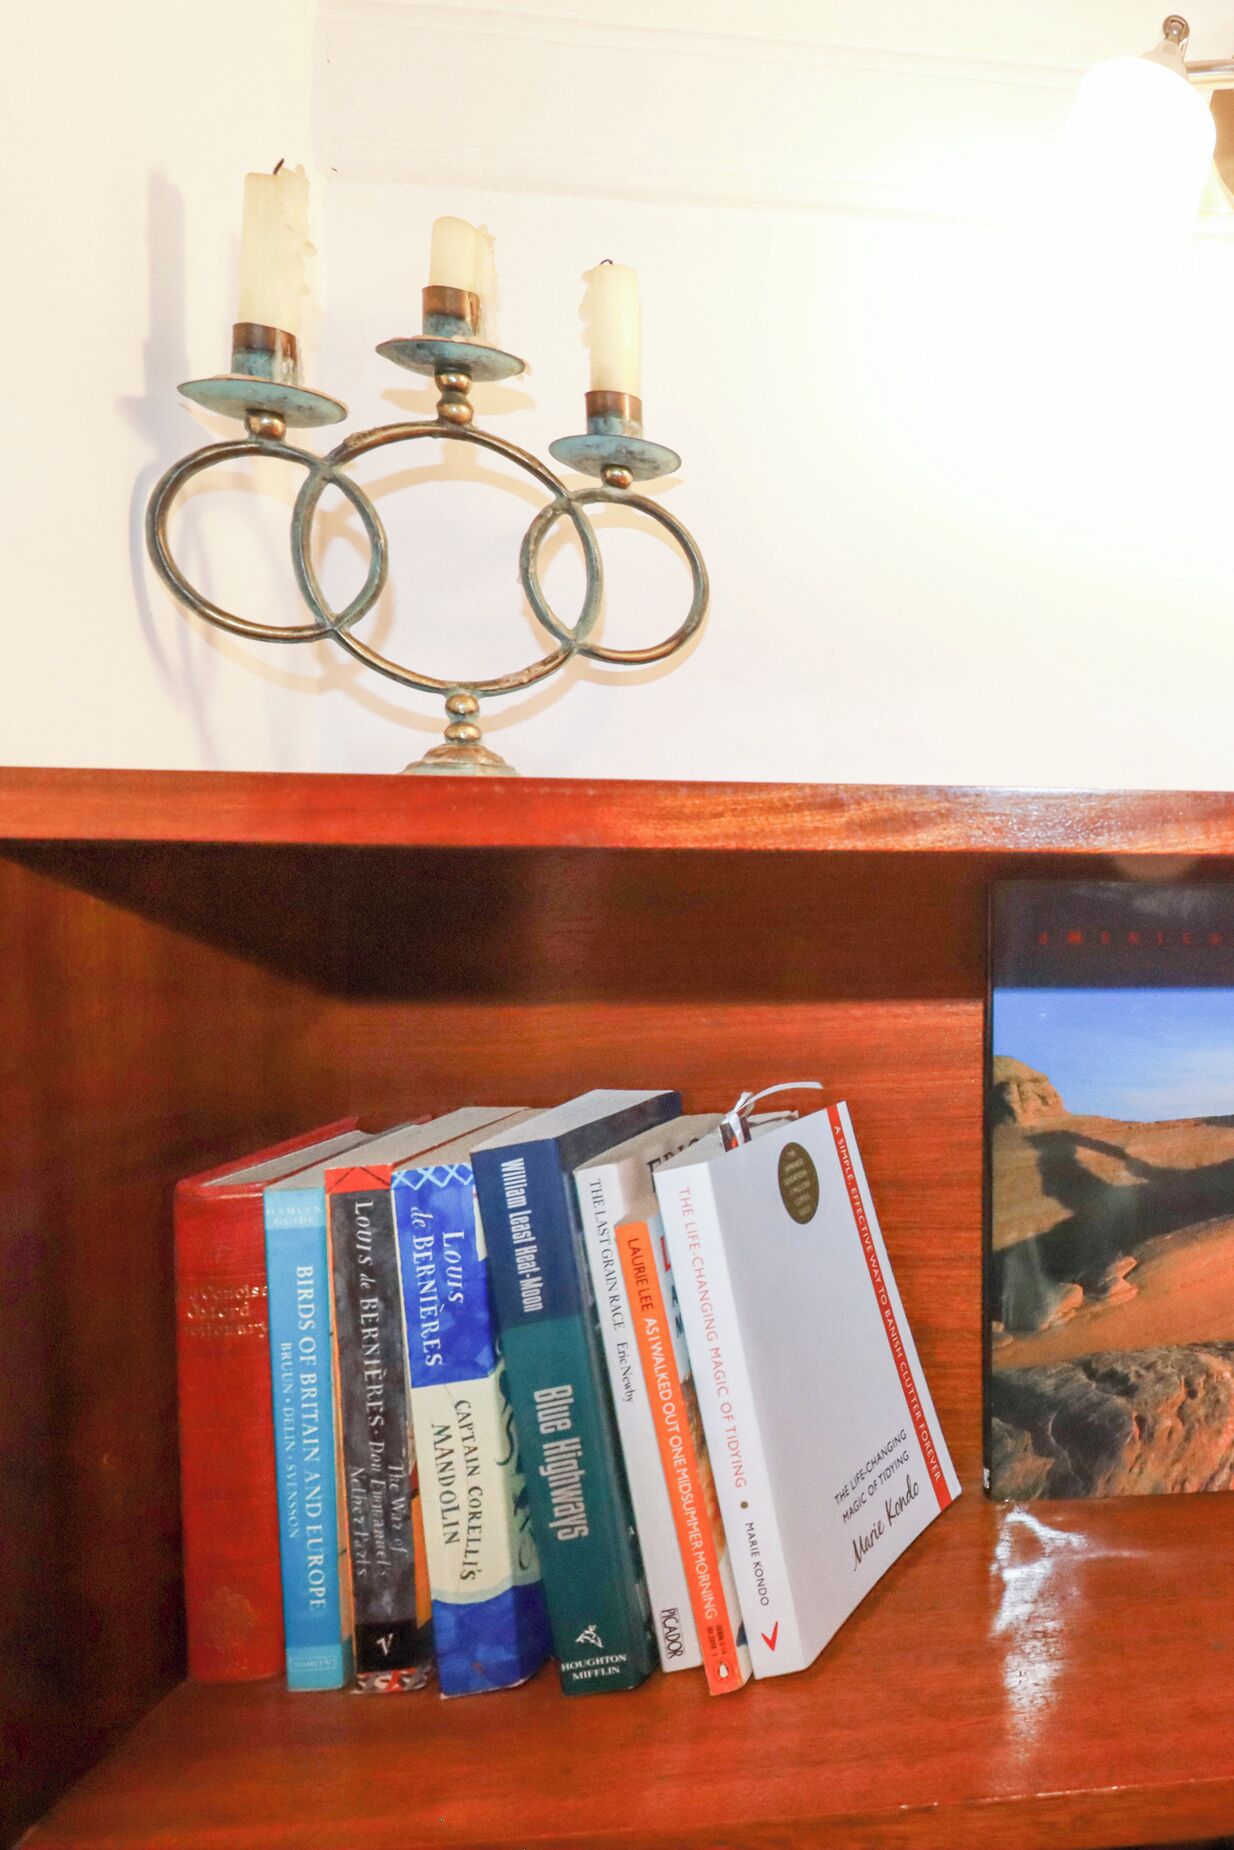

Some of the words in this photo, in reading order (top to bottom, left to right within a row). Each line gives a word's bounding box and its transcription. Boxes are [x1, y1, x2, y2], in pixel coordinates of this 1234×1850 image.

[499, 1157, 530, 1209] William
[587, 1177, 607, 1209] THE
[677, 1185, 696, 1217] THE
[409, 1206, 433, 1227] de
[507, 1209, 536, 1244] Least
[593, 1209, 612, 1246] LAST
[849, 1186, 874, 1253] EFFECTIVE
[358, 1273, 376, 1289] de
[512, 1244, 548, 1313] Heat-Moon
[599, 1247, 620, 1292] GRAIN
[626, 1237, 649, 1286] LAURIE
[683, 1219, 720, 1343] LIFE-CHANGING
[868, 1253, 883, 1284] WAY
[294, 1264, 314, 1330] BIRDS
[410, 1234, 450, 1366] BERNIÈRES
[607, 1294, 626, 1331] RACE
[636, 1287, 654, 1312] LEE
[877, 1286, 889, 1306] TO
[297, 1335, 315, 1365] OF
[642, 1315, 660, 1336] AS
[882, 1307, 904, 1359] BANISH
[280, 1342, 293, 1393] BRUUN
[358, 1297, 390, 1427] BERNIÈRES
[615, 1341, 630, 1365] Eric
[647, 1339, 674, 1402] WALKED
[708, 1346, 730, 1397] MAGIC
[533, 1383, 577, 1434] Blue
[617, 1366, 637, 1405] Newby
[898, 1360, 923, 1423] CLUTTER
[282, 1407, 295, 1452] DELIN
[298, 1372, 319, 1462] BRITAIN
[660, 1400, 680, 1435] OUT
[718, 1399, 735, 1423] OF
[368, 1440, 385, 1472] Don
[454, 1399, 482, 1483] CAPTAIN
[667, 1433, 687, 1468] ONE
[722, 1425, 747, 1490] TIDYING
[916, 1421, 942, 1482] FOREVER
[387, 1464, 406, 1489] The
[430, 1423, 462, 1544] MANDOLIN
[535, 1436, 592, 1542] Highways
[832, 1484, 851, 1507] THE
[846, 1427, 909, 1492] LIFE-CHANGING
[840, 1491, 868, 1525] MAGIC
[866, 1478, 879, 1498] OF
[877, 1447, 910, 1486] TIDYING
[284, 1463, 299, 1539] SVENSSON
[302, 1470, 320, 1516] AND
[347, 1466, 368, 1523] Nether
[389, 1497, 409, 1530] War
[674, 1466, 704, 1552] MIDSUMMER
[460, 1485, 485, 1582] CORELLI'S
[744, 1521, 760, 1558] MARIE
[847, 1511, 885, 1572] Marie
[882, 1470, 920, 1529] Kondo
[304, 1524, 324, 1611] EUROPE
[352, 1531, 370, 1576] Parts
[691, 1549, 718, 1621] MORNING
[751, 1561, 769, 1607] KONDO
[658, 1607, 686, 1658] PICADOR
[561, 1654, 627, 1672] HOUGHTON
[572, 1666, 620, 1681] MIFFLIN
